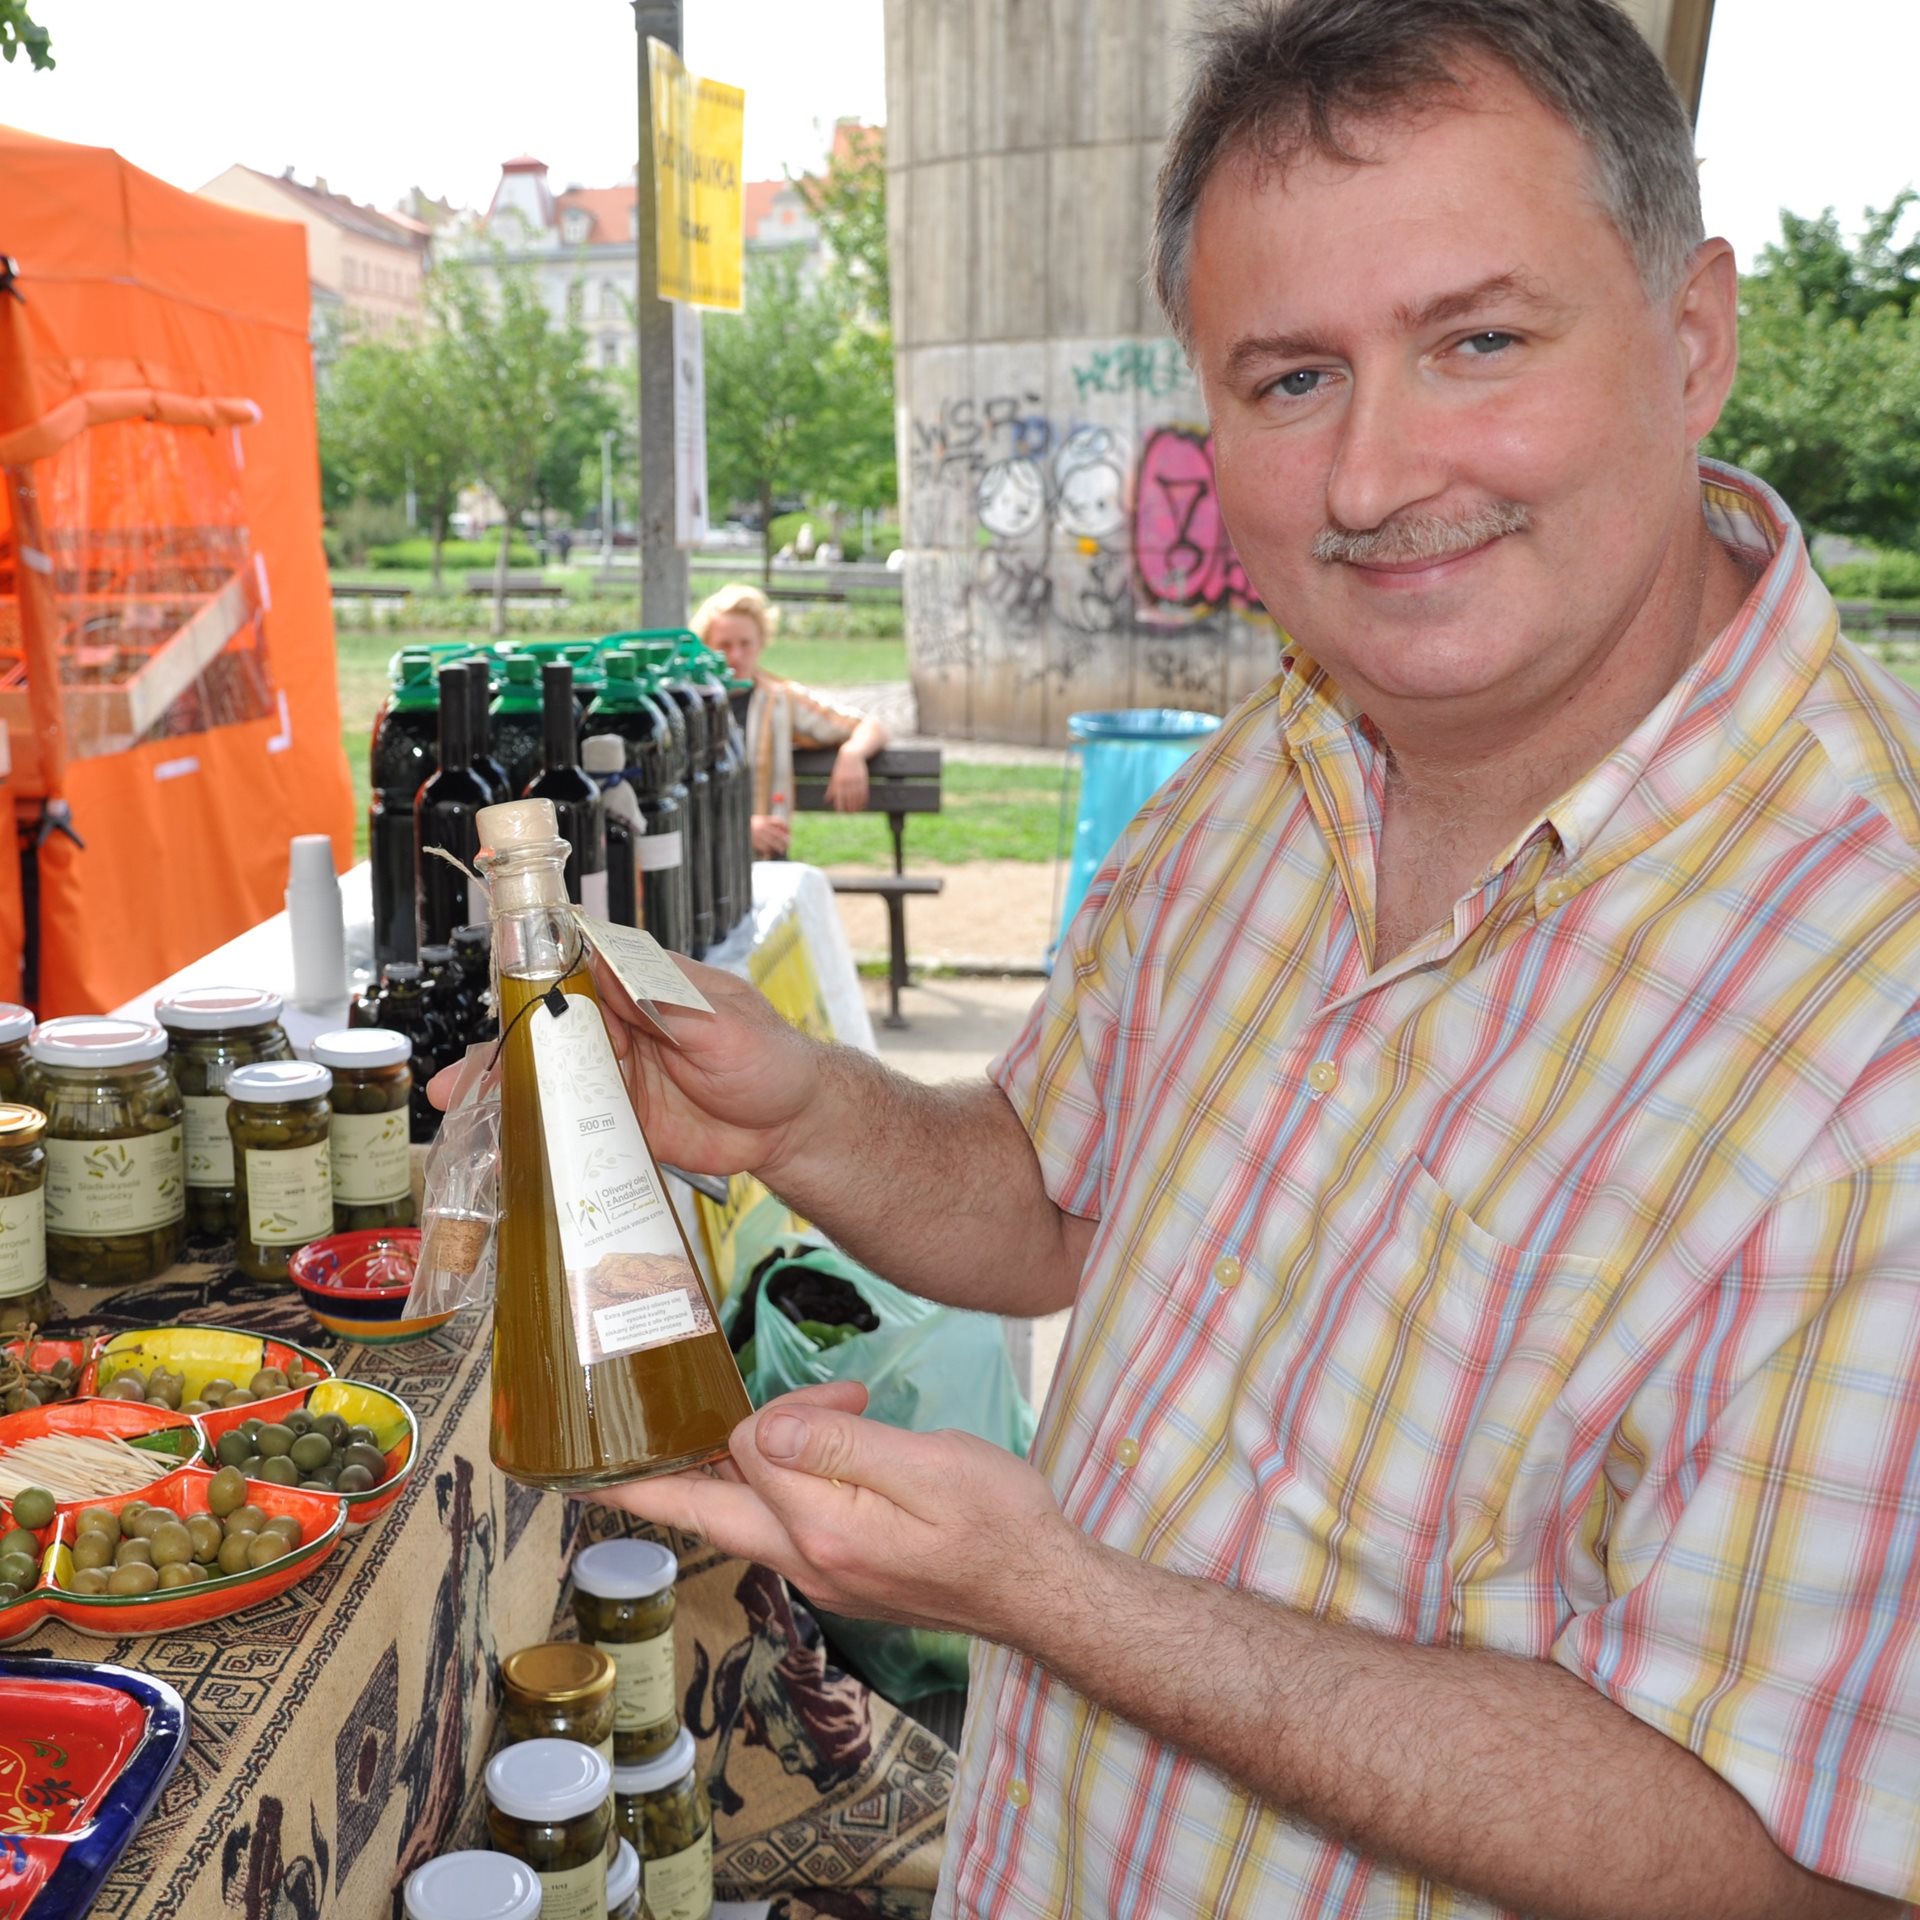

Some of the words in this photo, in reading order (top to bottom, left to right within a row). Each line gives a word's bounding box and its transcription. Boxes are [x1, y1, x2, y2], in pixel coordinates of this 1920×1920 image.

[579, 1119, 600, 1132] 500
[602, 1116, 615, 1127] ml
[601, 1179, 633, 1198] Olivový
[634, 1173, 648, 1186] olej
